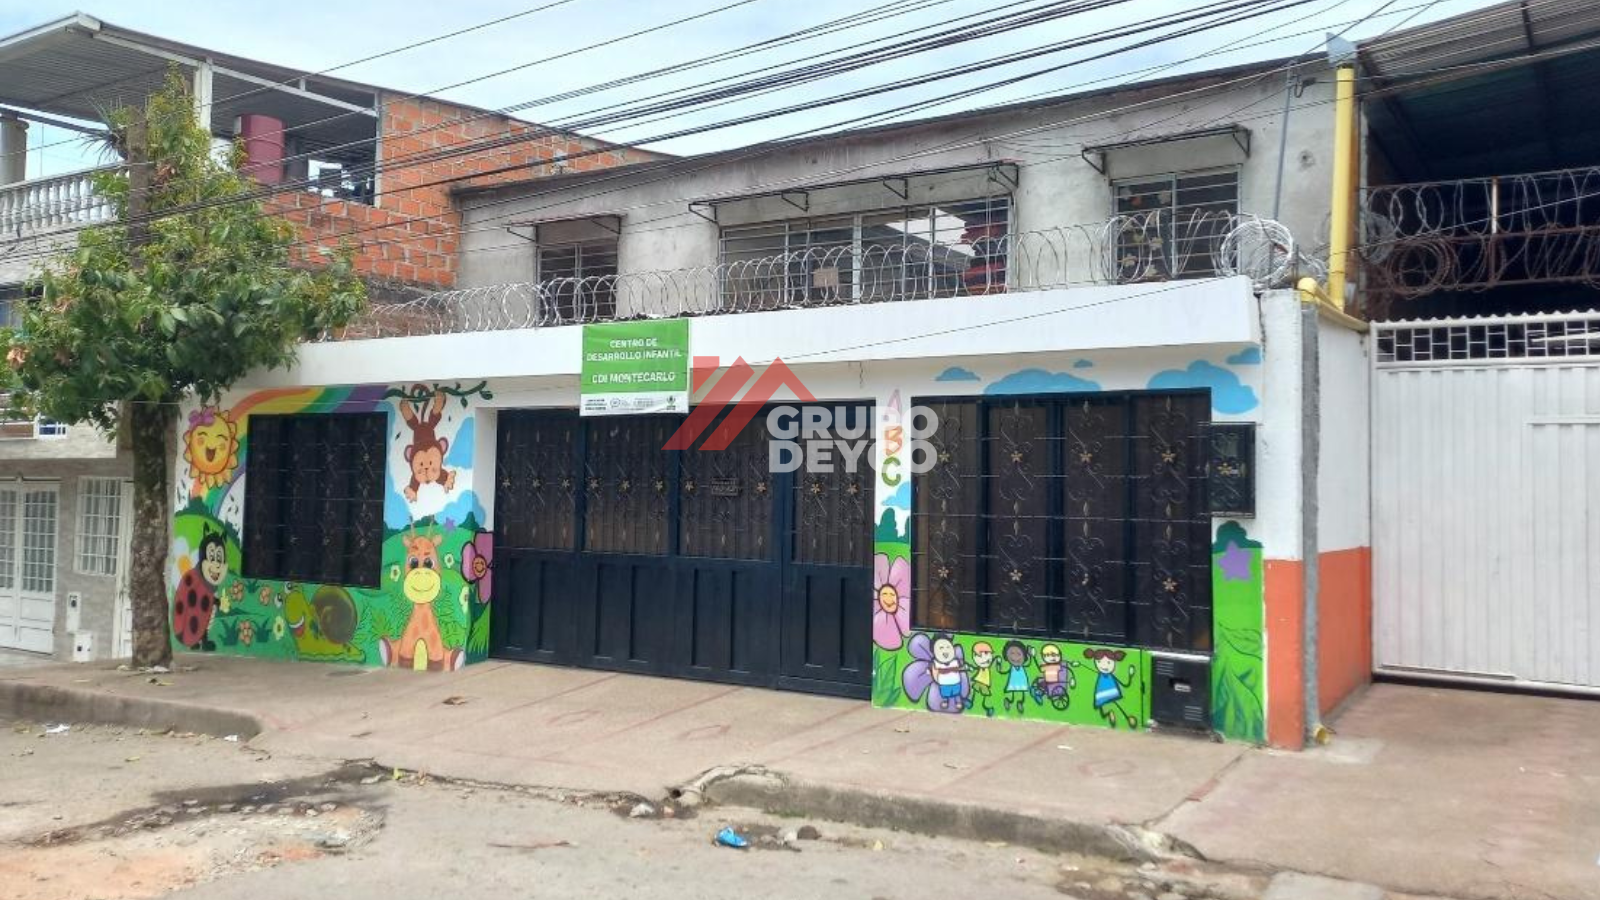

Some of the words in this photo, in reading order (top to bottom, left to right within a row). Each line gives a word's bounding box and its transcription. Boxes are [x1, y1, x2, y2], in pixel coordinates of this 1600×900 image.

[609, 338, 644, 348] CENTRO
[645, 337, 658, 347] DE
[586, 351, 641, 362] DESARROLLO
[643, 349, 683, 360] INFANTIL
[592, 374, 608, 384] CDI
[609, 371, 676, 384] MONTECARLO
